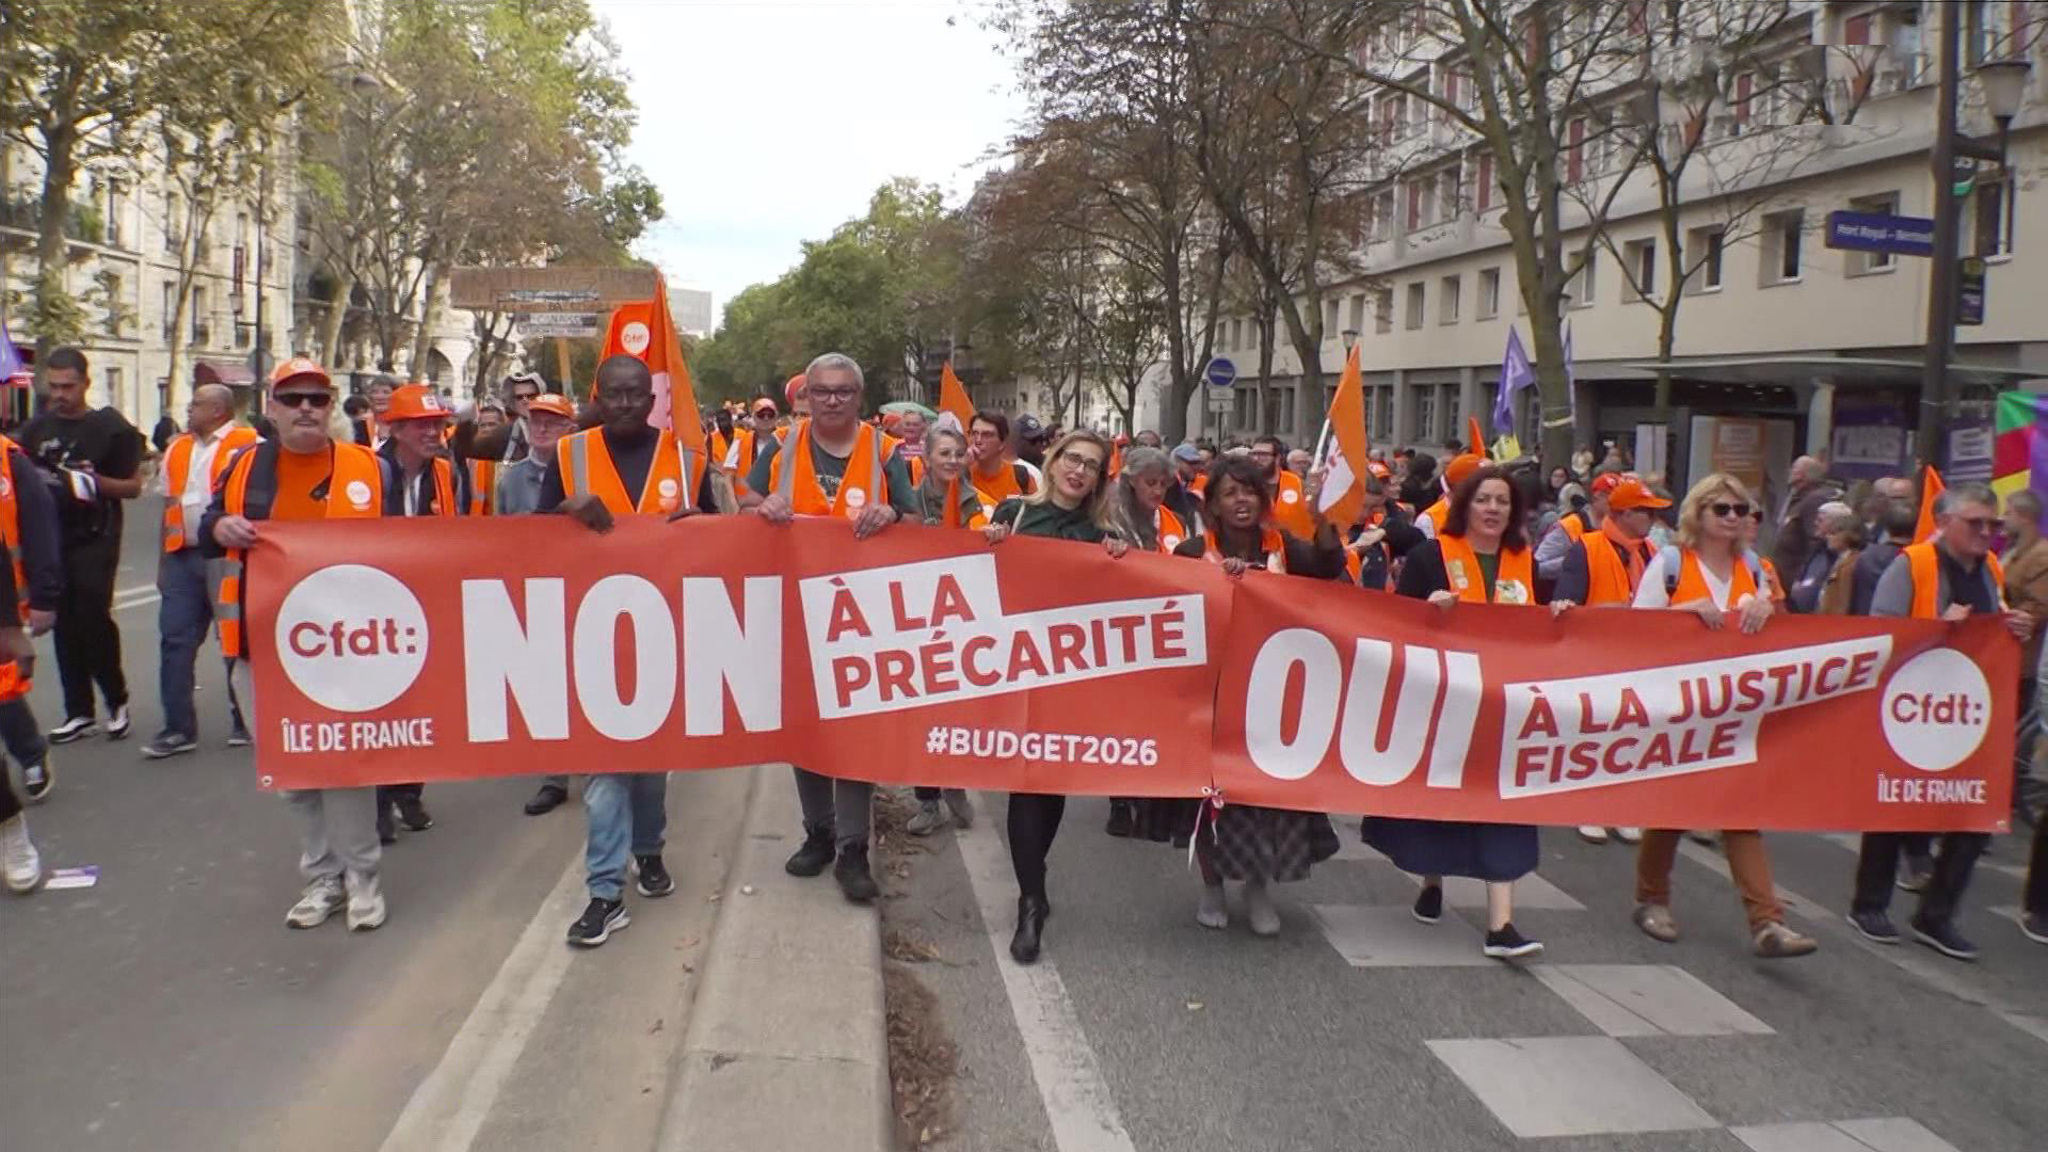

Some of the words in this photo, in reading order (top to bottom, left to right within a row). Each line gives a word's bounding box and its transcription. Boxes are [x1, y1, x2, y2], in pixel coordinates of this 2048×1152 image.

[288, 617, 417, 657] Cfdt:
[826, 577, 872, 642] À
[888, 574, 975, 634] LA
[461, 574, 783, 742] NON
[832, 600, 1187, 708] PRÉCARITÉ
[1245, 628, 1483, 789] OUI
[1517, 686, 1559, 740] À
[1578, 687, 1650, 734] LA
[1668, 651, 1878, 725] JUSTICE
[1891, 693, 1983, 726] Cfdt:
[282, 717, 313, 752] ÎLE
[318, 723, 346, 752] DE
[352, 718, 434, 751] FRANCE
[926, 726, 1159, 766] #BUDGET2026
[1514, 720, 1742, 788] FISCALE
[1877, 769, 1902, 803] ÎLE
[1904, 779, 1924, 803] DE
[1926, 779, 1987, 804] FRANCE
